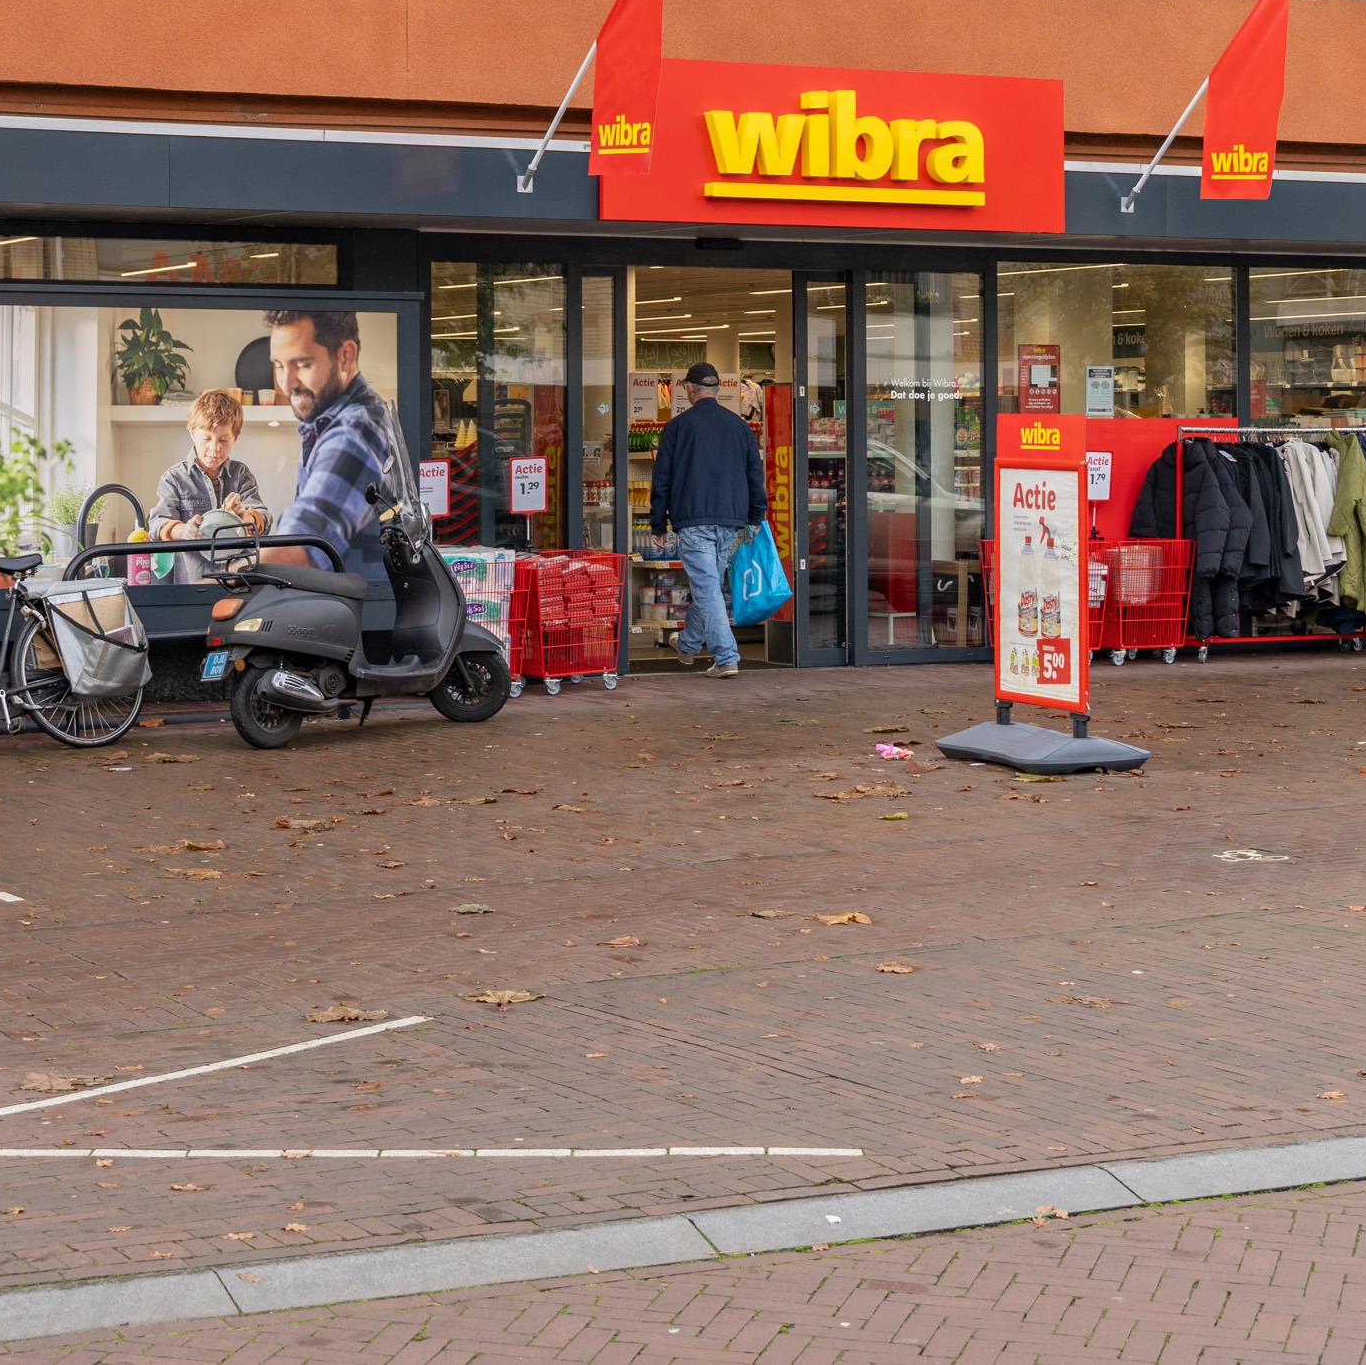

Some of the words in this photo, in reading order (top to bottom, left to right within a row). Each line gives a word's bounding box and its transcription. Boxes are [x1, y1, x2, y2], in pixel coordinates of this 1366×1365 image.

[598, 114, 651, 147] wibra
[704, 90, 985, 184] wibra
[1211, 144, 1268, 173] wibra
[1264, 324, 1300, 339] Wonen
[1314, 322, 1344, 337] koken
[633, 378, 655, 387] Actie
[890, 378, 920, 388] Welkom
[922, 378, 931, 389] bij
[932, 378, 958, 388] Wibra.
[890, 390, 906, 399] Dat
[908, 390, 925, 399] doe
[927, 391, 936, 401] je
[938, 390, 963, 401] goed.
[1020, 422, 1060, 445] wibra
[515, 463, 543, 475] Actie
[1087, 457, 1110, 466] Actie
[420, 467, 445, 478] Actie
[1090, 474, 1106, 485] 1.79
[520, 481, 540, 495] 1.29
[771, 446, 790, 559] wibra
[1013, 481, 1057, 511] Actie
[1042, 653, 1065, 679] 5.00
